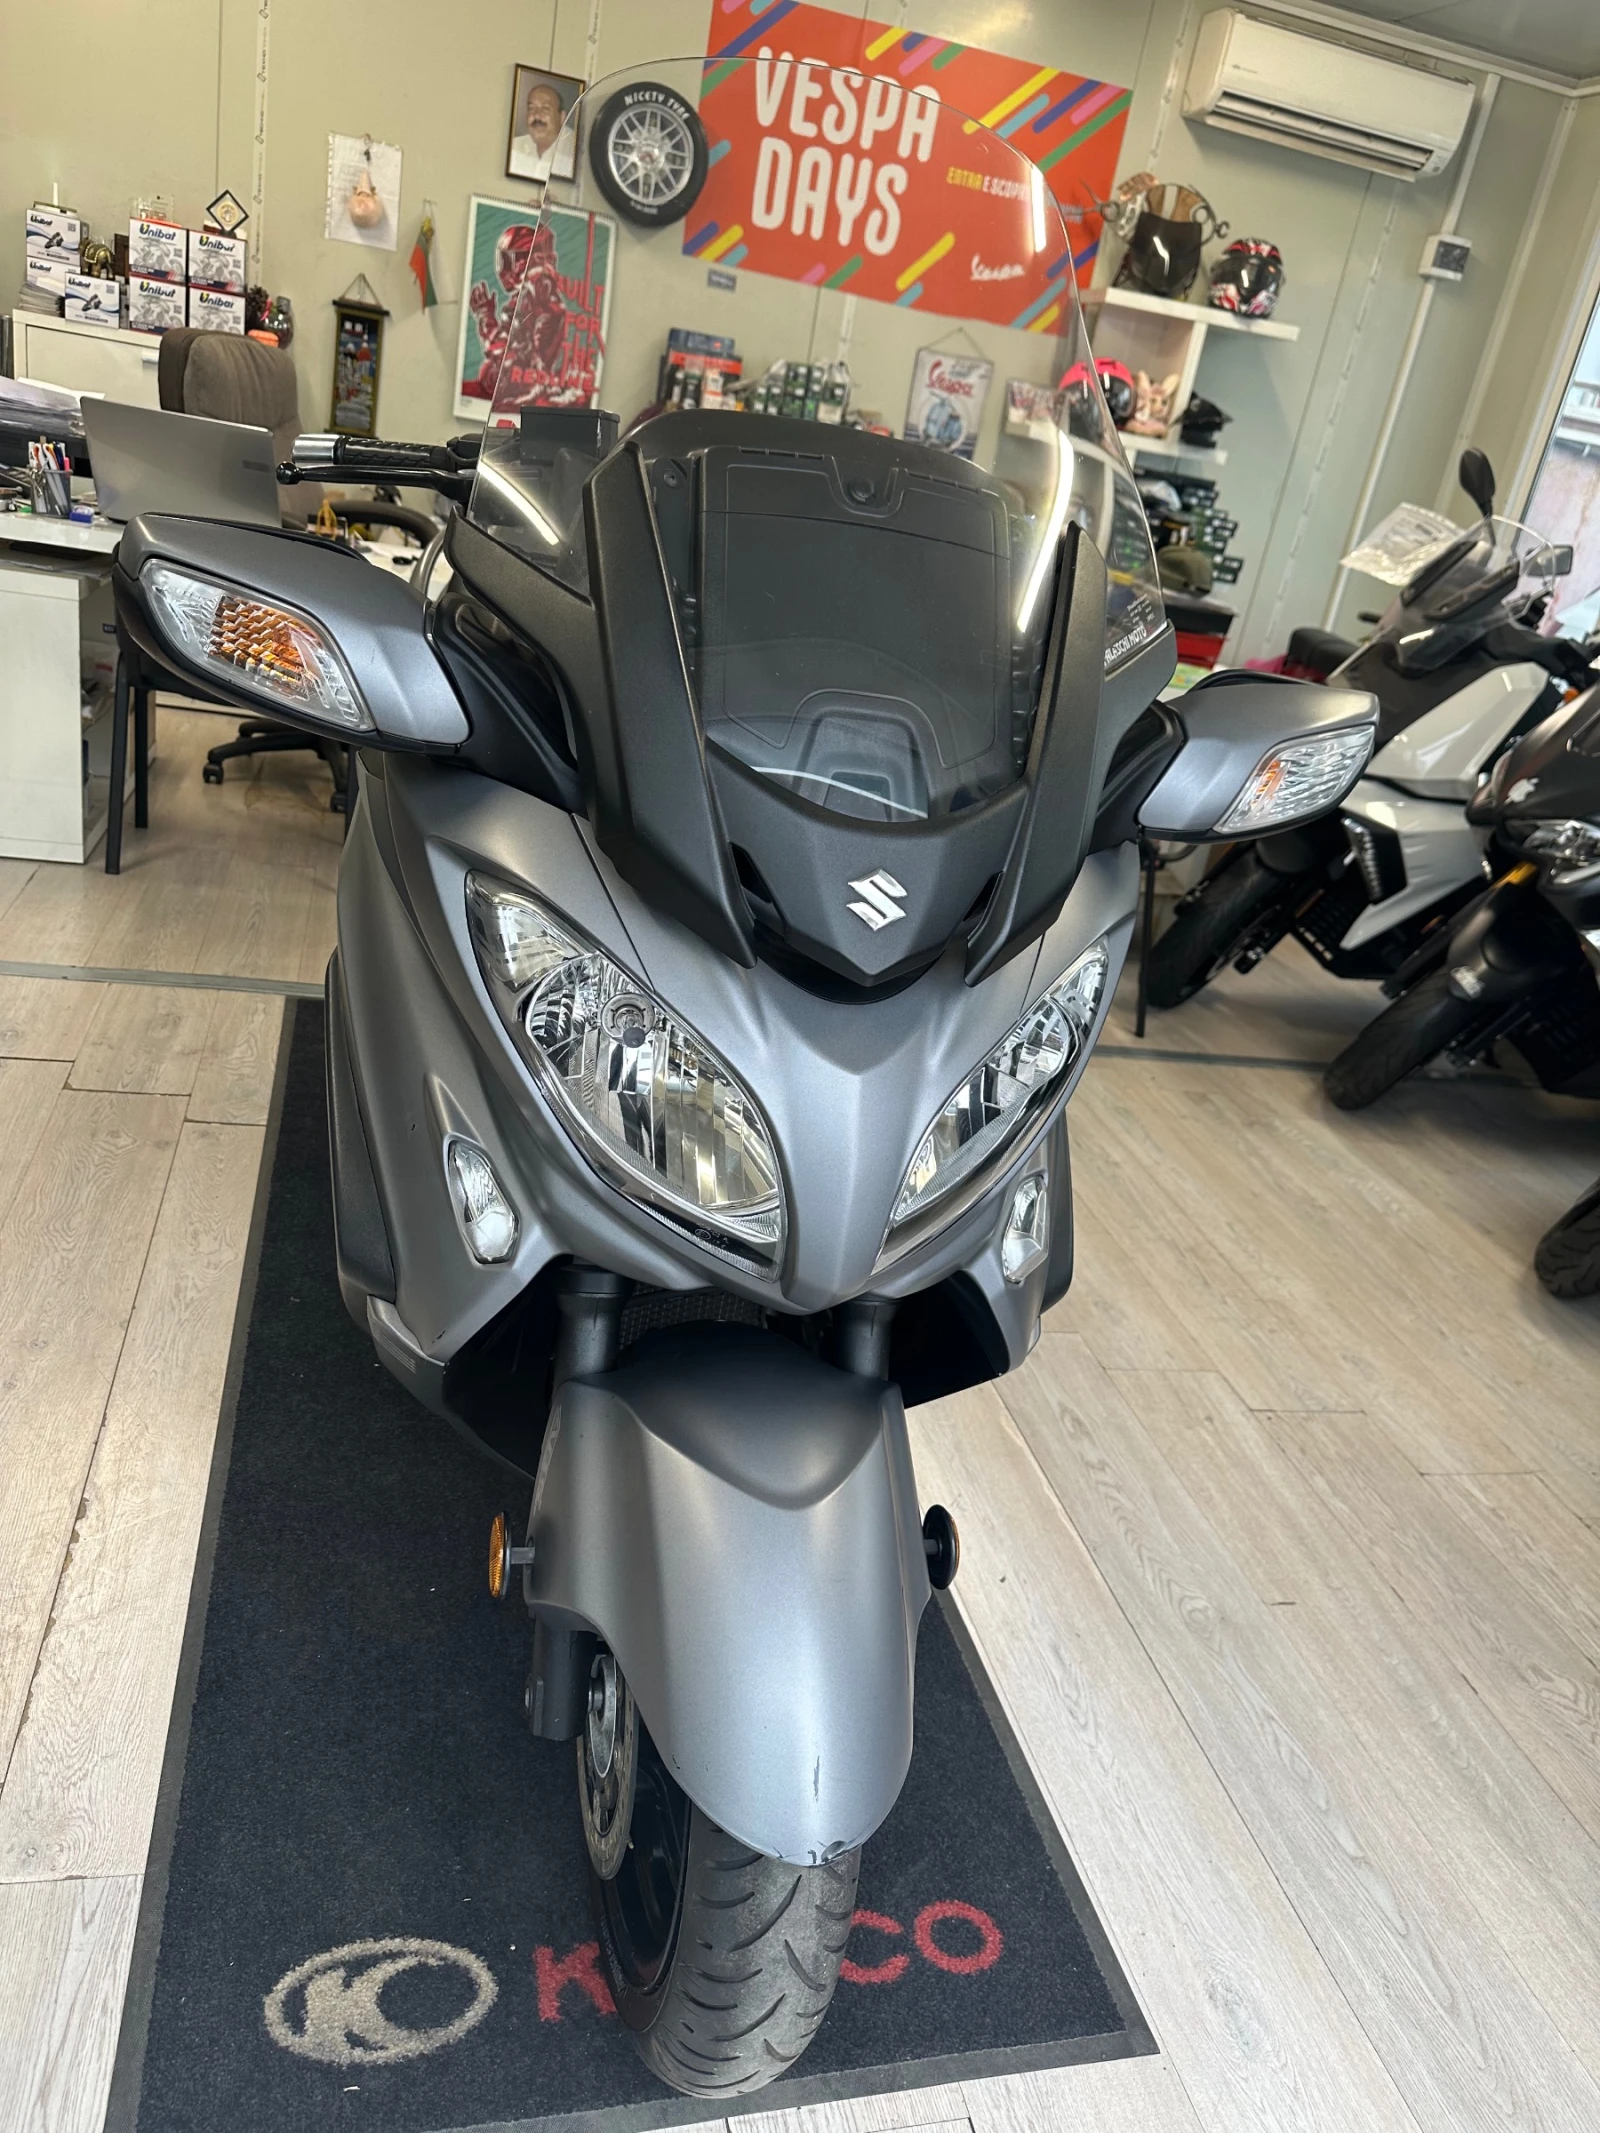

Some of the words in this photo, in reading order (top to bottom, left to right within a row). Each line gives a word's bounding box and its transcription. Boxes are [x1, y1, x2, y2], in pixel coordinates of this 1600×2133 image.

[624, 91, 665, 106] NICETY
[756, 46, 941, 163] VESPA
[947, 166, 984, 191] ENTRA
[752, 136, 908, 256] DAYS
[30, 215, 53, 226] Unibat
[139, 223, 176, 241] Unibat
[199, 235, 235, 252] Unibat
[30, 261, 52, 272] Unibat
[68, 277, 91, 288] Unibat
[139, 281, 176, 298] Unibat
[199, 292, 235, 309] Unibat
[564, 310, 605, 357] FOR
[926, 359, 974, 398] Vespa
[1103, 635, 1131, 668] ALASCHI
[1127, 624, 1147, 647] MOTO
[533, 1899, 1002, 2022] KCO
